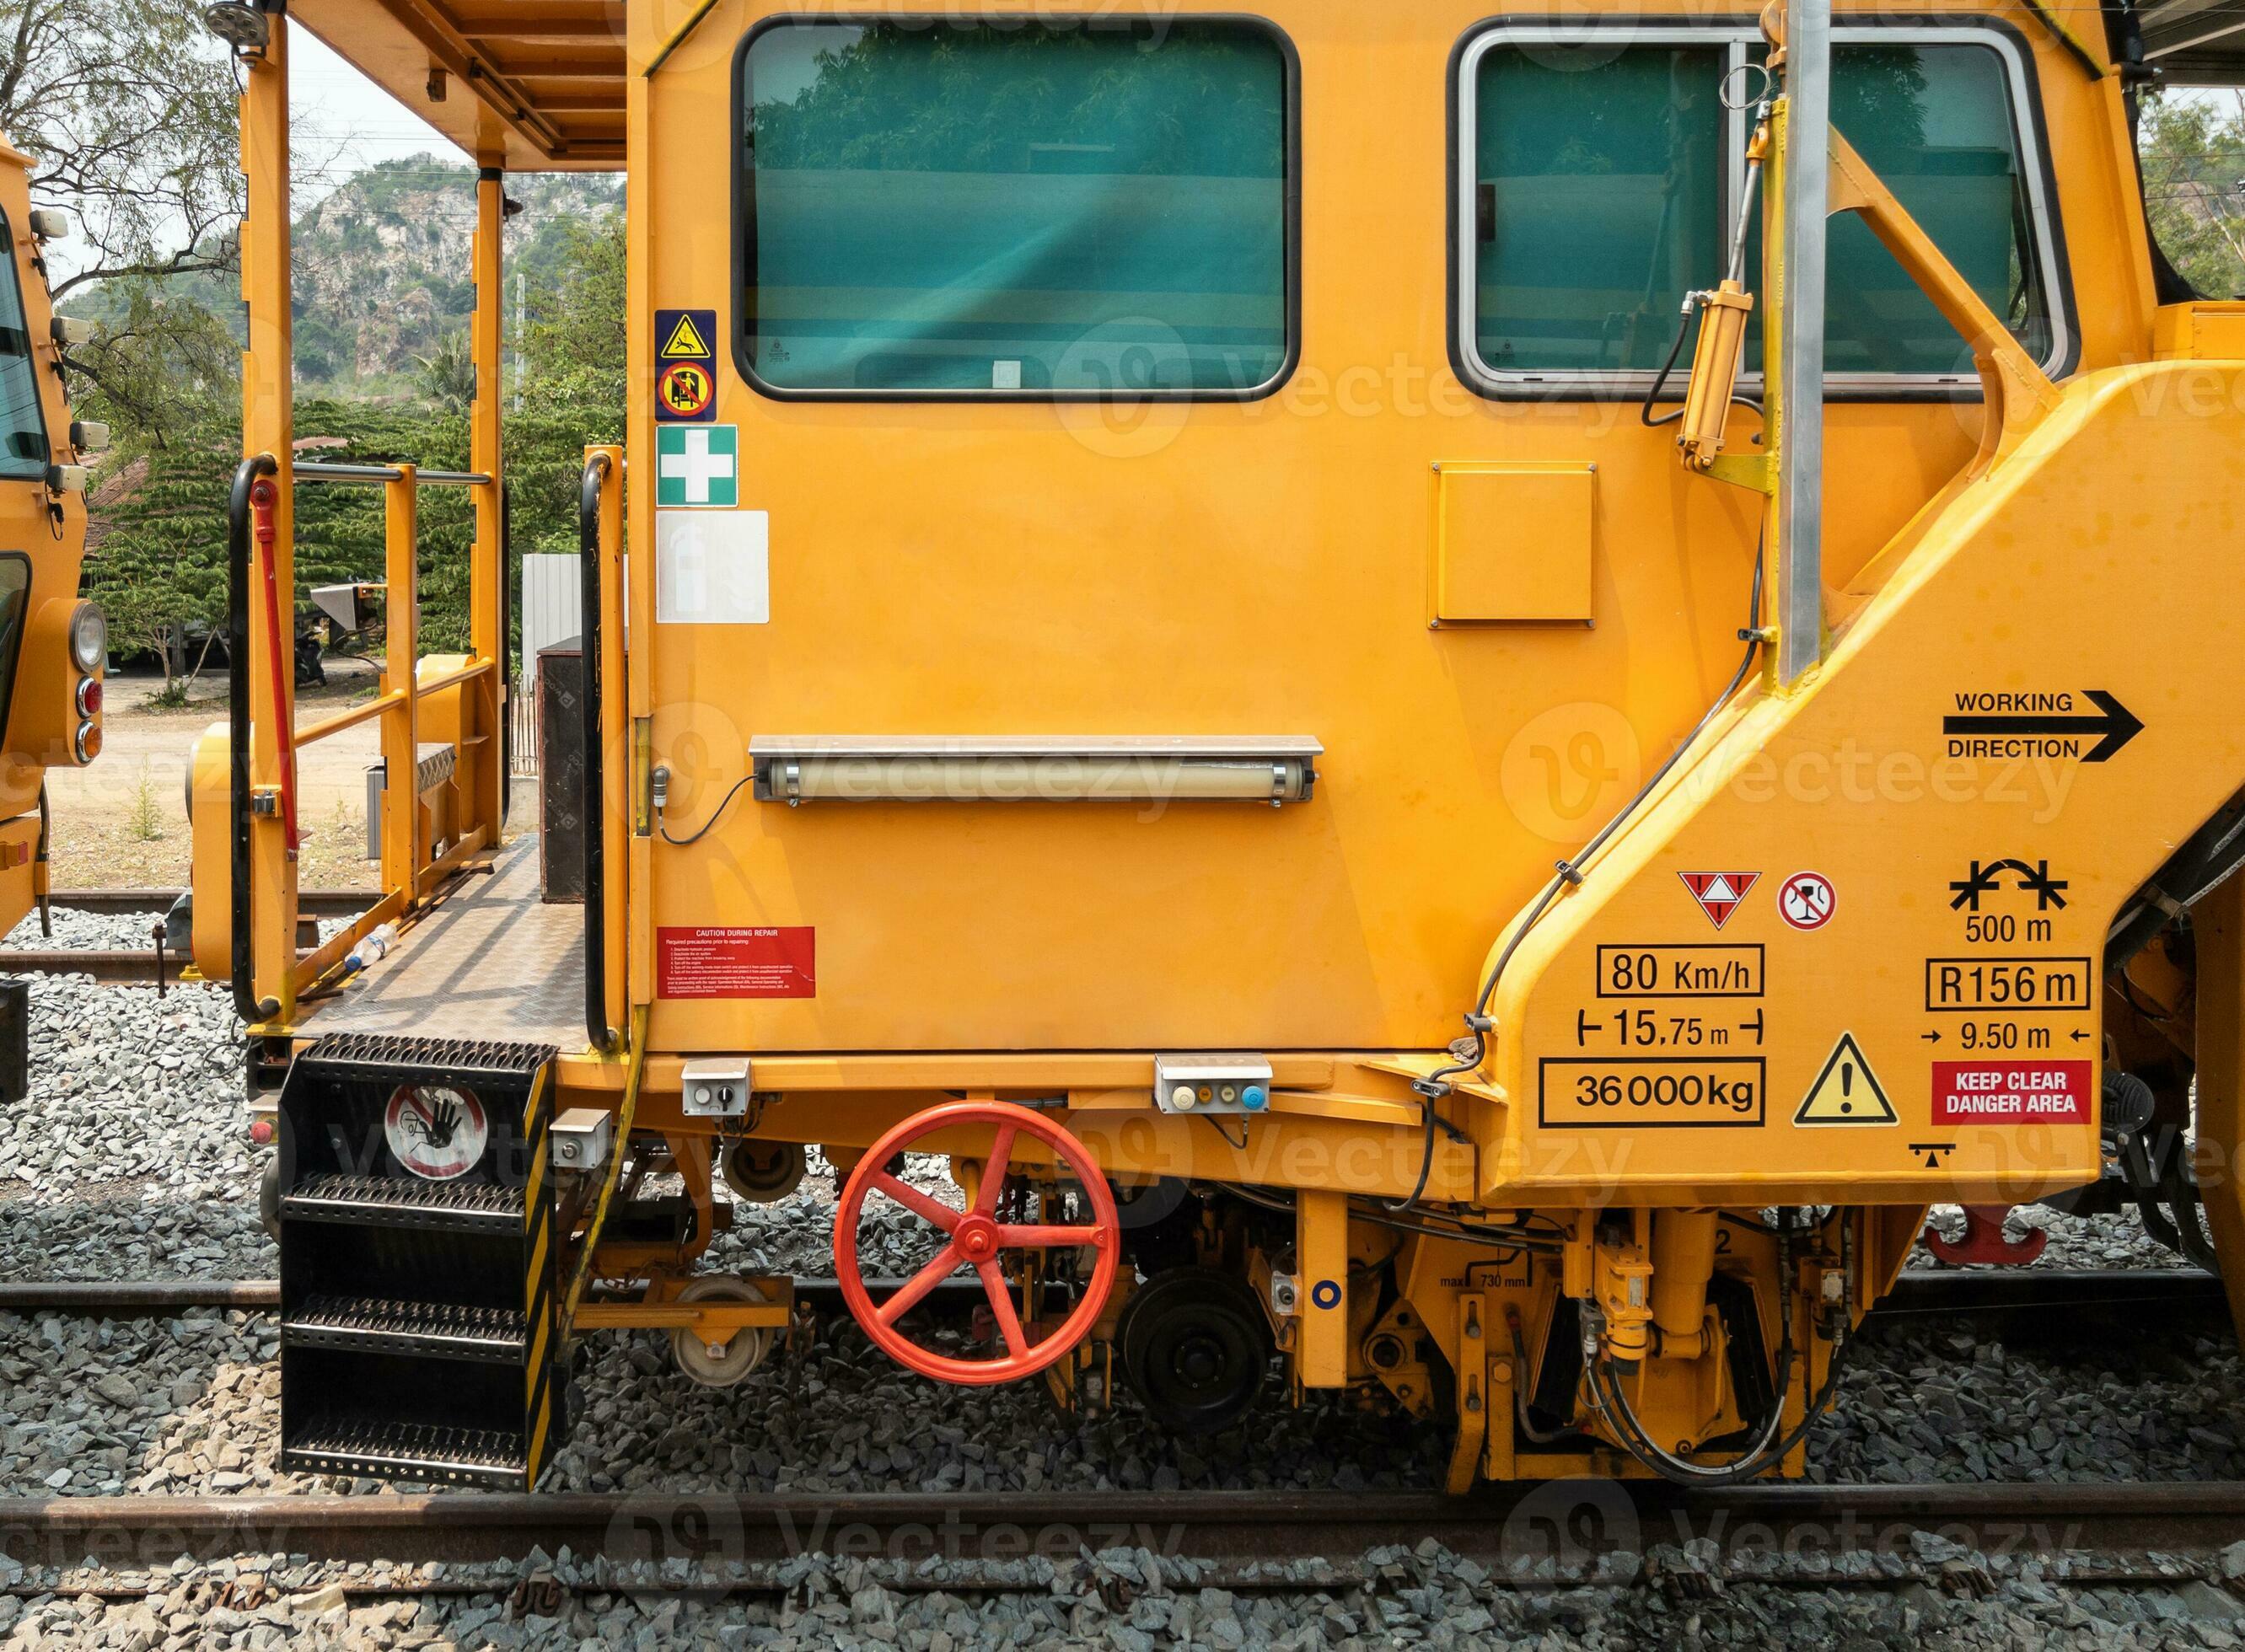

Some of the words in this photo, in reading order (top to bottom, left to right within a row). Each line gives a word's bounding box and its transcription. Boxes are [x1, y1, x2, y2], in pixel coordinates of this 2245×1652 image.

[1955, 693, 2073, 711] WORKING
[1947, 739, 2080, 758] DIRECTION
[1965, 914, 2016, 942] 500
[2026, 918, 2052, 941] m
[1612, 954, 1657, 990] 80
[1674, 961, 1749, 990] Km/h
[1711, 1027, 1728, 1044] m
[2027, 1027, 2050, 1049] m
[1956, 1073, 2002, 1090] KEEP
[2007, 1072, 2066, 1090] CLEAR
[1946, 1096, 2021, 1113] DANGER
[2026, 1095, 2076, 1113] AREA
[1440, 1276, 1464, 1287] max
[1480, 1274, 1501, 1287] 730
[1505, 1278, 1525, 1287] mm
